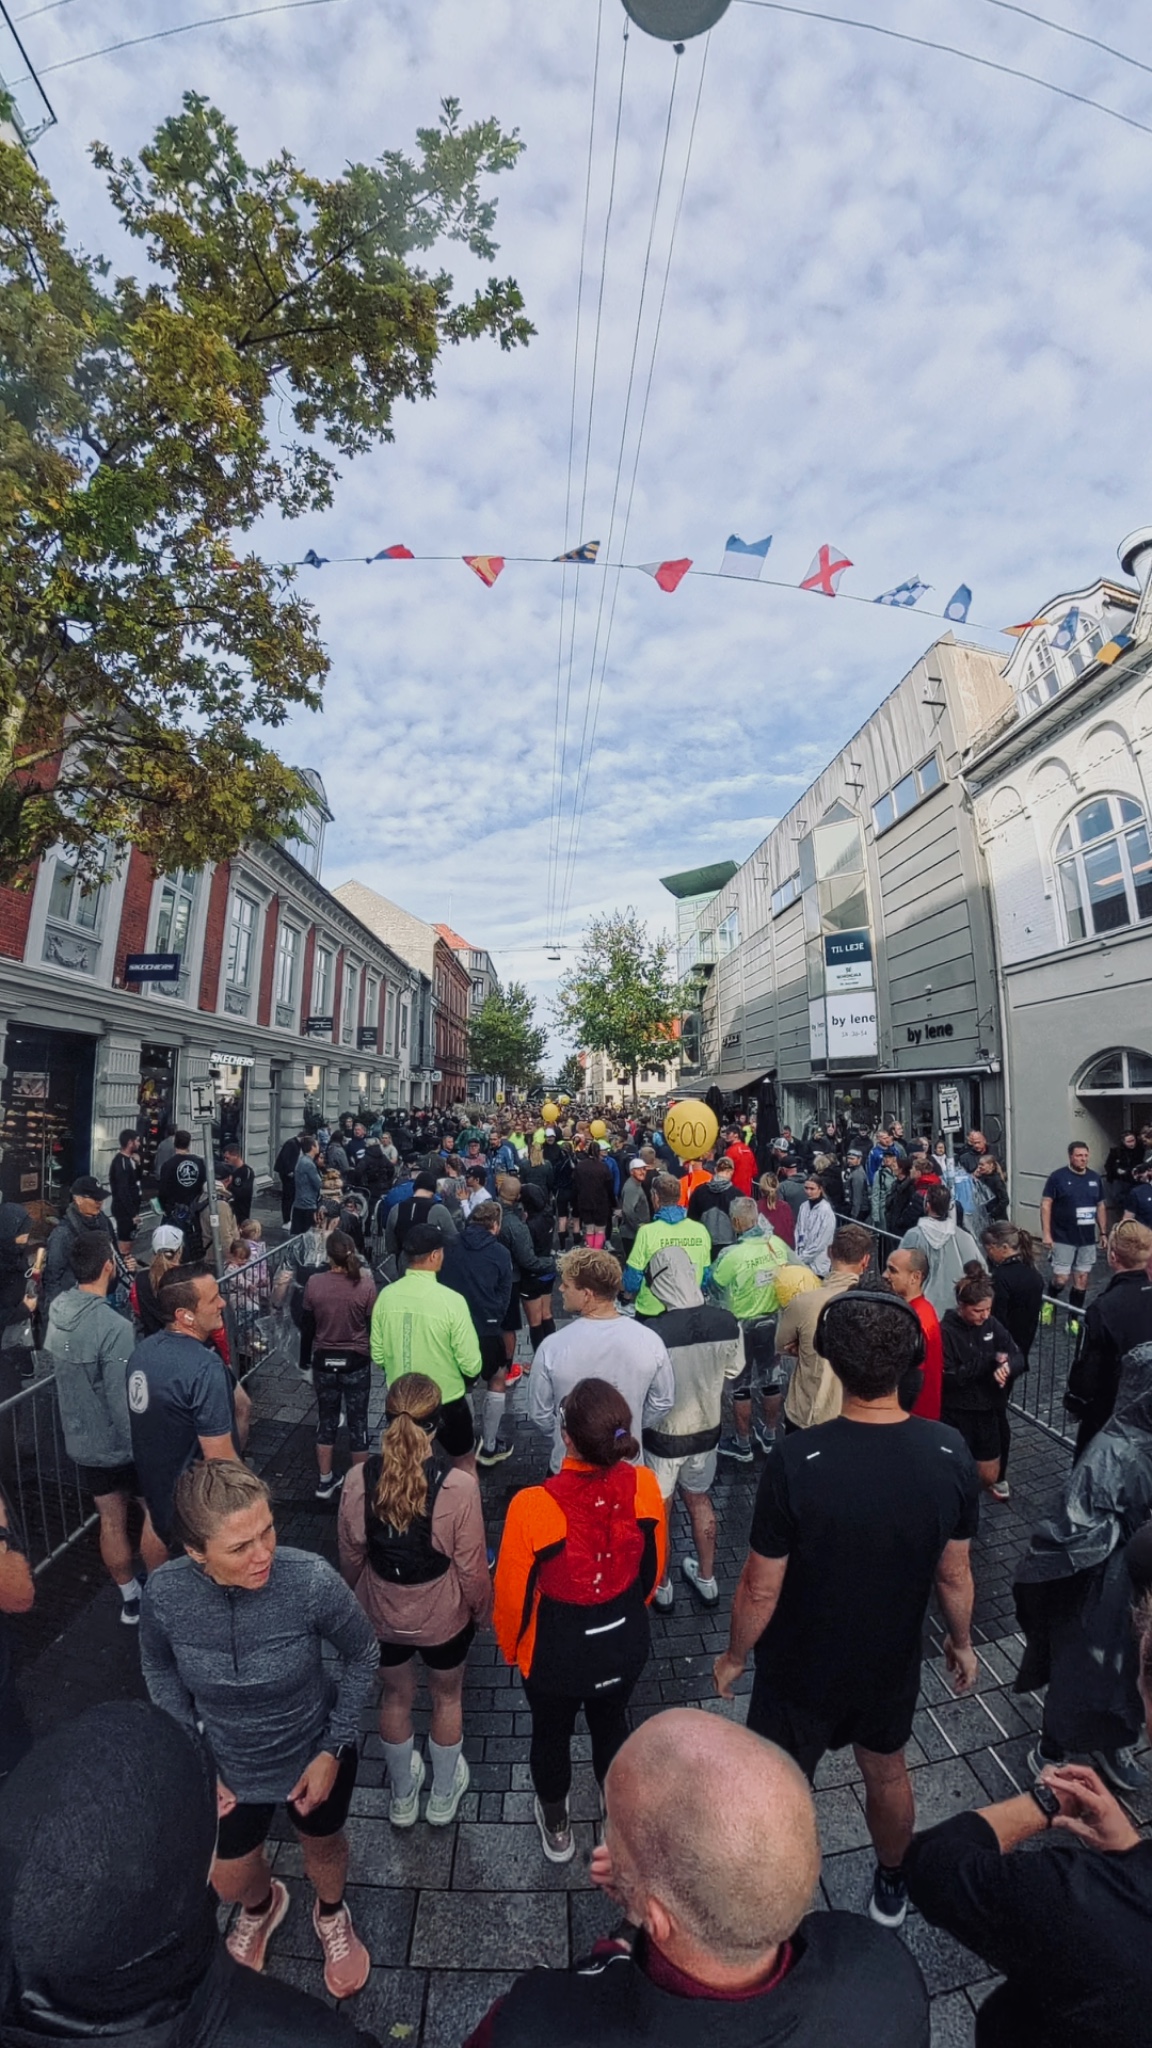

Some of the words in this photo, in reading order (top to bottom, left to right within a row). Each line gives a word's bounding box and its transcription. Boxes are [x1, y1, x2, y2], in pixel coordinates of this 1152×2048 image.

[831, 946, 843, 954] TIL
[845, 942, 864, 952] LEJE
[832, 1016, 846, 1027] by
[850, 1014, 876, 1024] lene
[907, 1027, 922, 1044] by
[925, 1023, 953, 1039] lene
[210, 1052, 255, 1067] SKECHERS
[667, 1117, 707, 1148] 2:00
